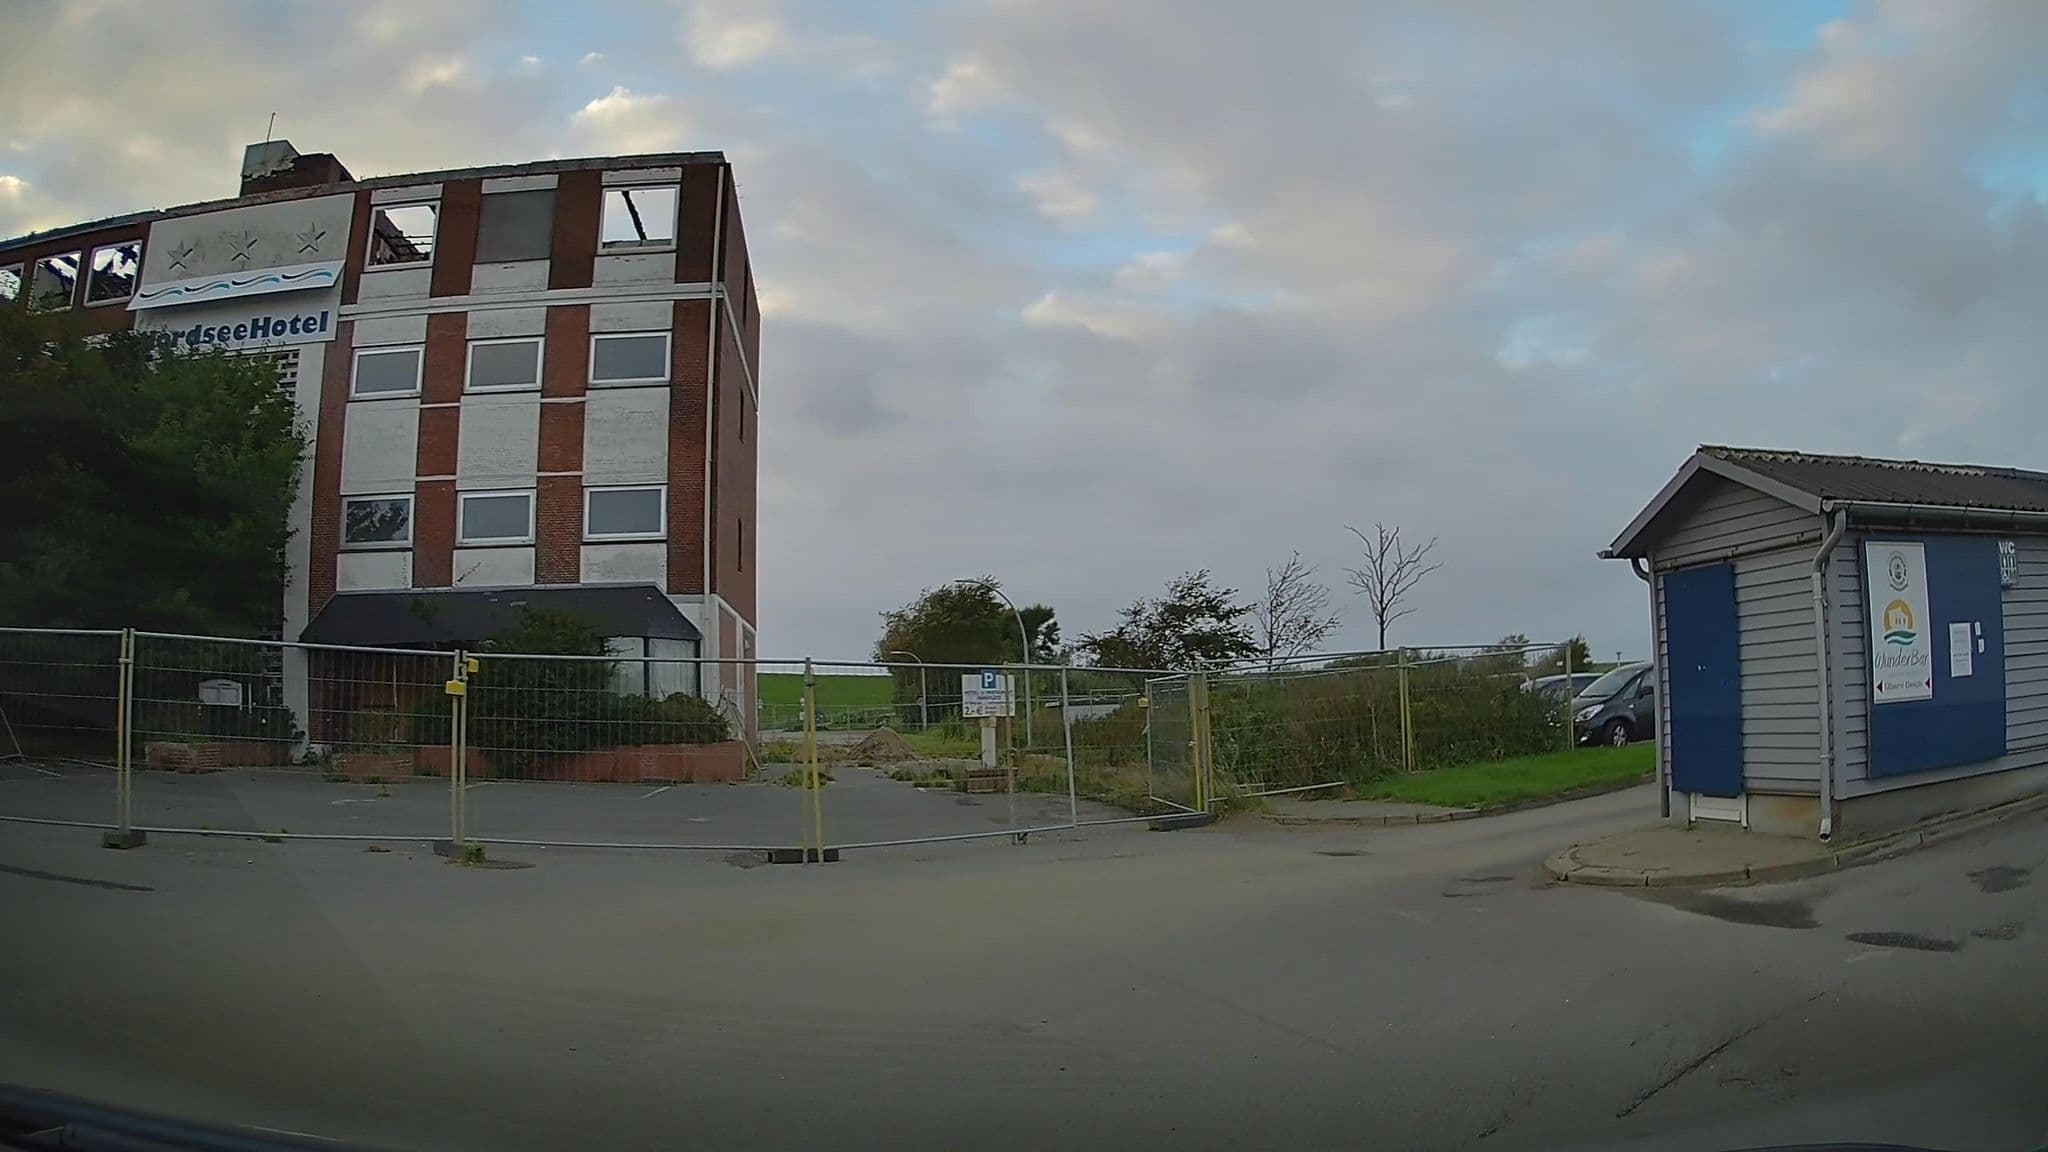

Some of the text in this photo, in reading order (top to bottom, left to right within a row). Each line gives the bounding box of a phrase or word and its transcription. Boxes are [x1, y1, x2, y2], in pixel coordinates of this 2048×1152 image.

[1999, 541, 2015, 554] WC
[1875, 647, 1928, 670] WunderBar
[984, 672, 994, 687] P
